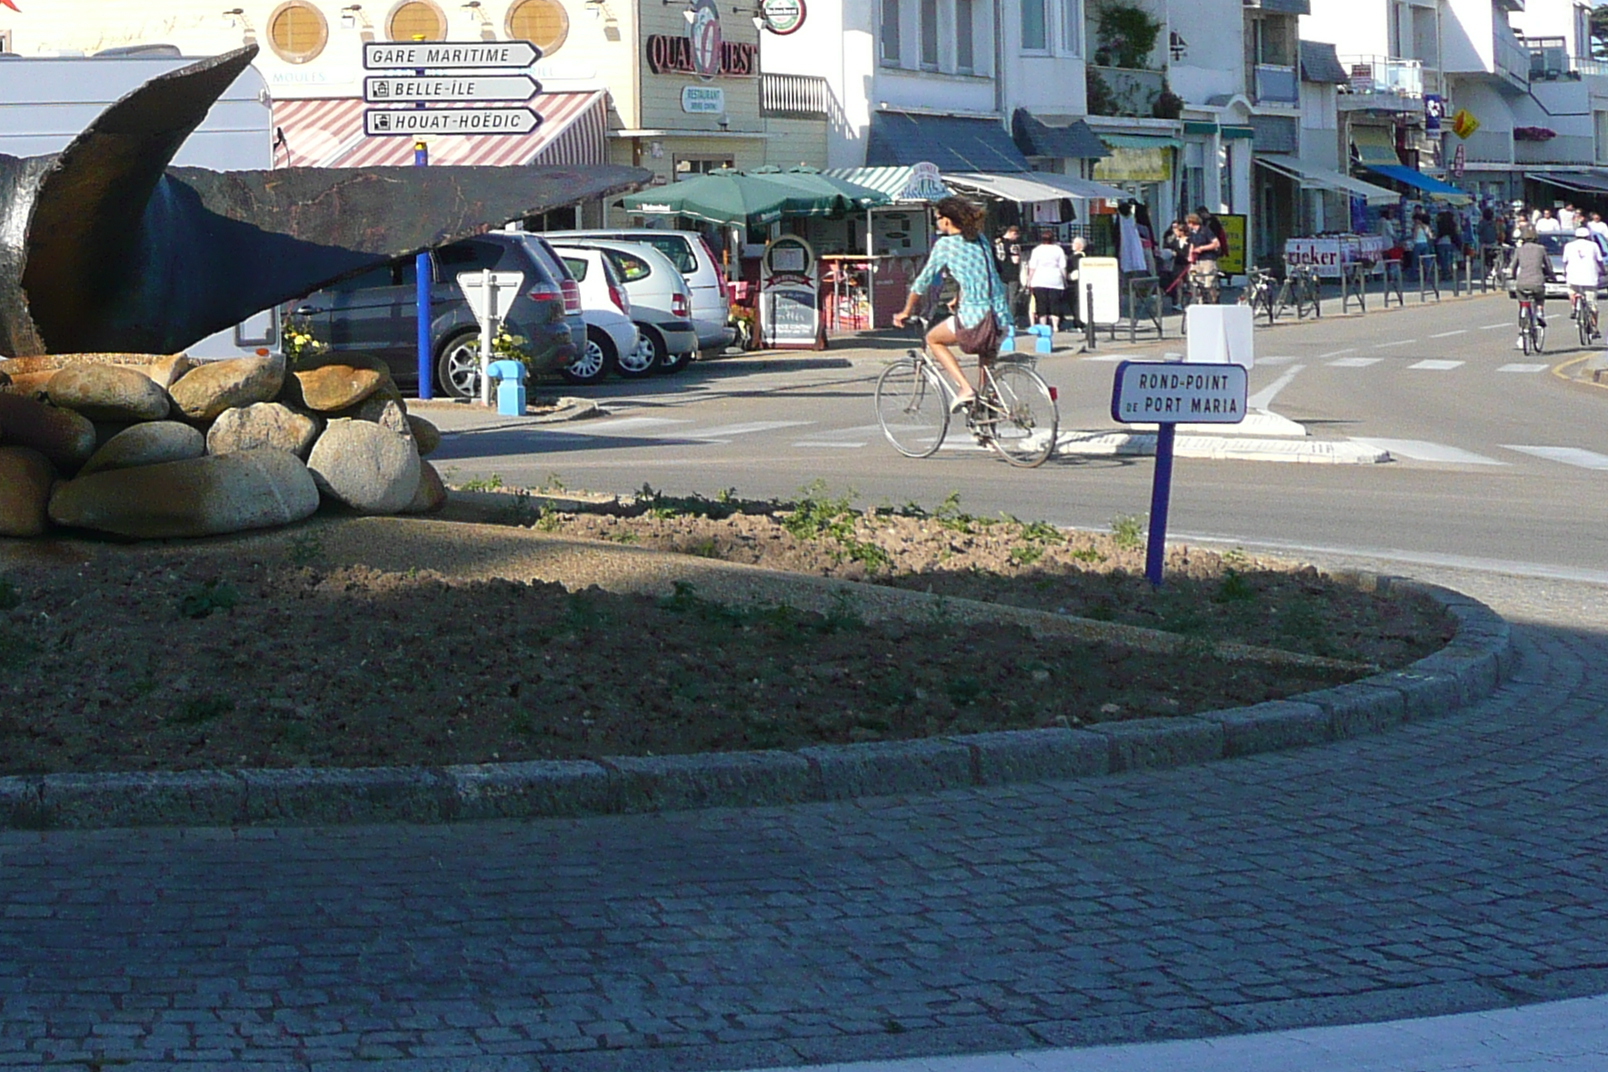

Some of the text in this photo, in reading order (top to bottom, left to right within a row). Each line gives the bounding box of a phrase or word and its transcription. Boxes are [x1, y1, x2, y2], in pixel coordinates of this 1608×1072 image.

[372, 47, 510, 64] GARE MARITIME
[647, 35, 694, 75] QUAI
[394, 79, 476, 96] BELLE-ÎLE
[394, 111, 522, 129] HOUAT-HOËDIC
[1288, 244, 1337, 266] rieker
[1139, 373, 1229, 390] ROND-POINT
[1126, 397, 1238, 413] DE PORT MARIA
